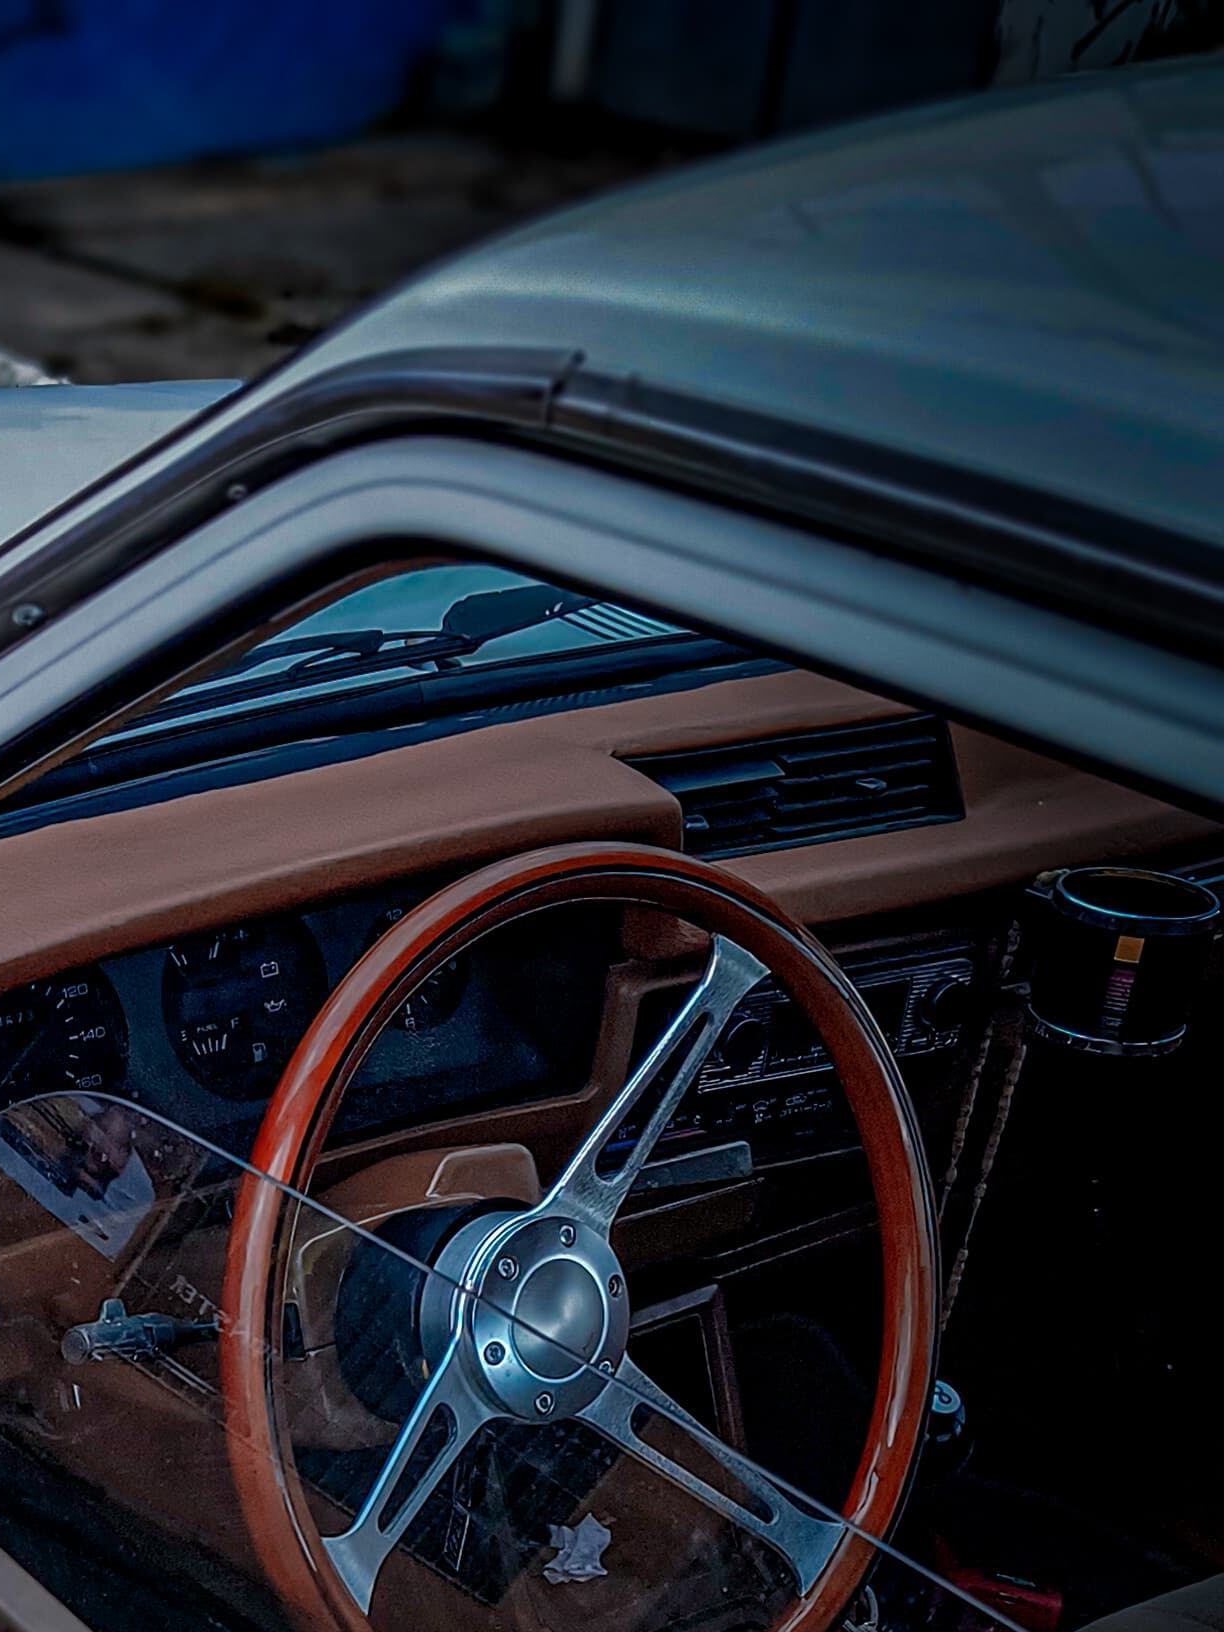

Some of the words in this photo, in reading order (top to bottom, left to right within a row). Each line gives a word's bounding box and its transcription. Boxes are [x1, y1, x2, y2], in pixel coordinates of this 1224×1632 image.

[61, 982, 89, 999] 120
[78, 1025, 107, 1042] 140
[75, 1072, 103, 1090] 160
